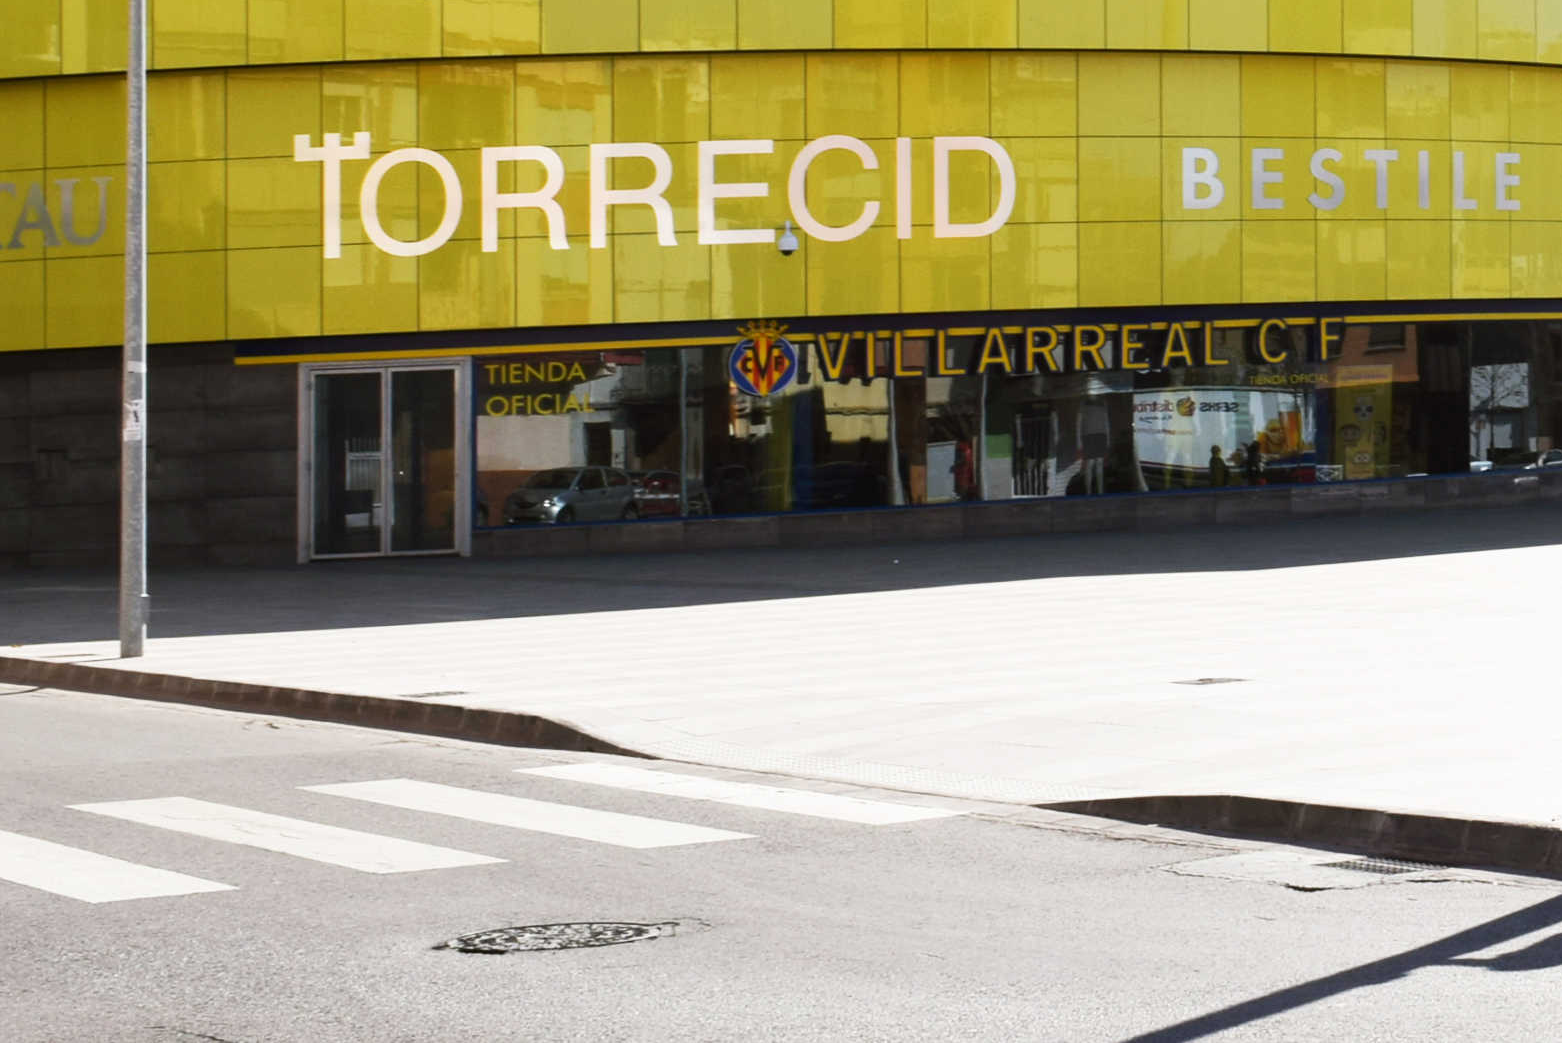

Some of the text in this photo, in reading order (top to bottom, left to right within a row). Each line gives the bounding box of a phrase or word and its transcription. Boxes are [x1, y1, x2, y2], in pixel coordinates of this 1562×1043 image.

[294, 132, 1016, 259] TORRECID
[1181, 146, 1522, 211] BESTILE
[485, 360, 588, 386] TIENDA
[816, 316, 1345, 379] VILLARREAL C F
[485, 393, 595, 417] OFICIAL
